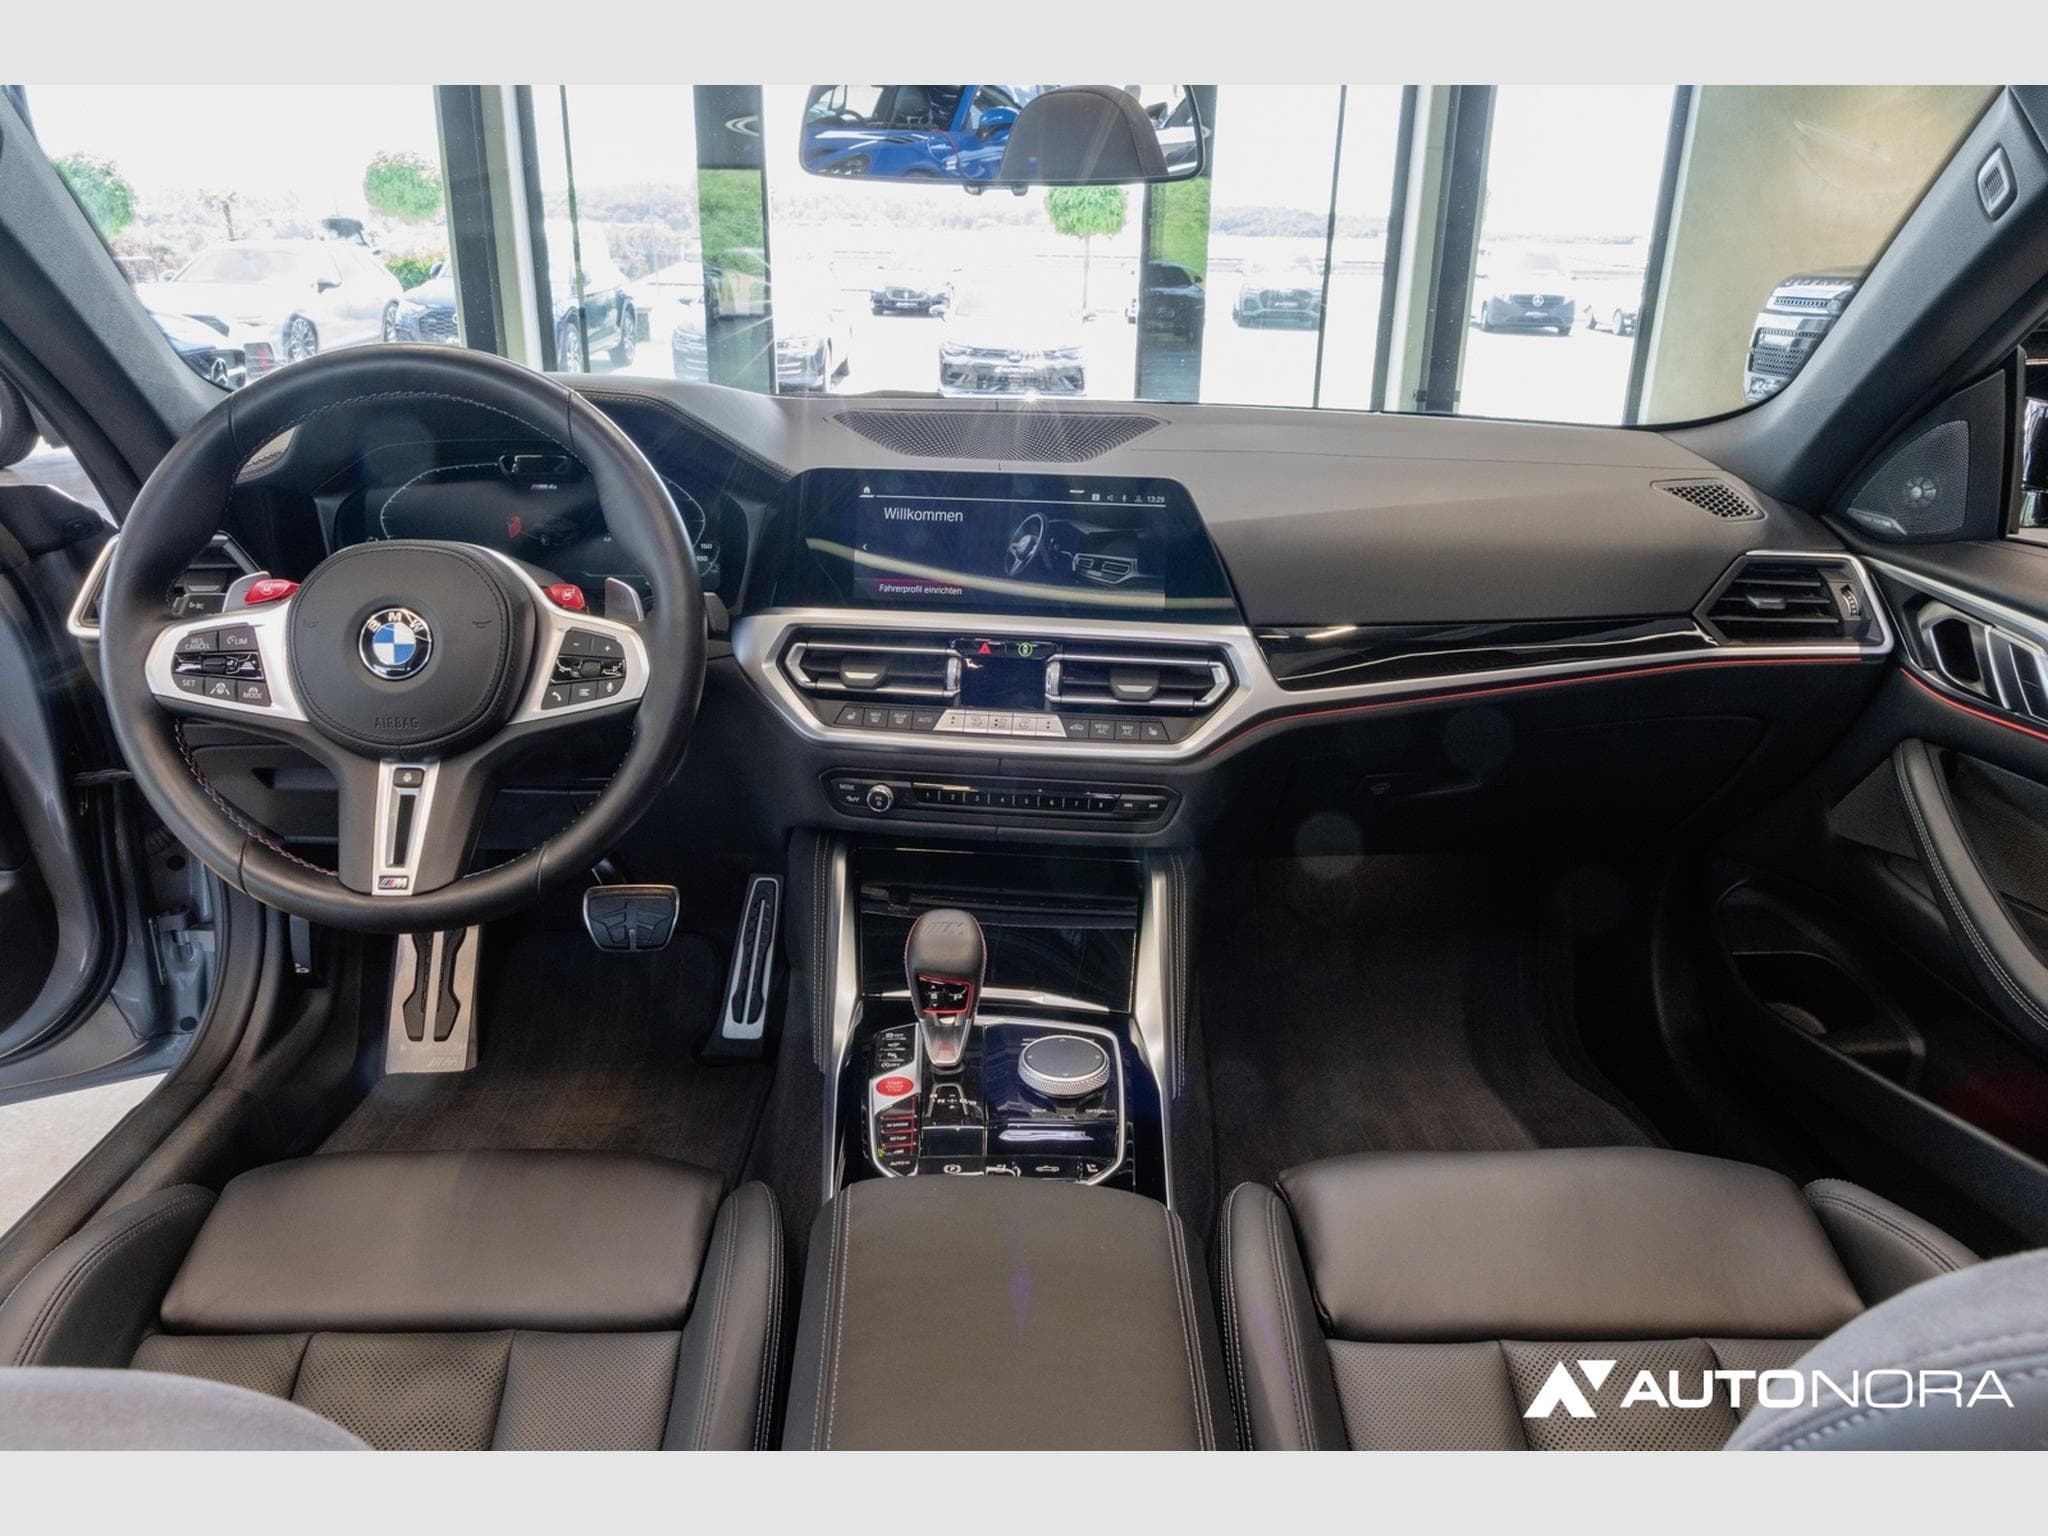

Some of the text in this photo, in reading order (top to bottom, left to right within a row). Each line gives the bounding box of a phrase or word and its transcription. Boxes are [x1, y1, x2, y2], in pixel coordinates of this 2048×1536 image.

[884, 507, 964, 522] Willkommen
[879, 583, 962, 595] Fahrerprofil einrichten
[367, 611, 424, 633] BMW
[374, 716, 421, 730] AIRBAG
